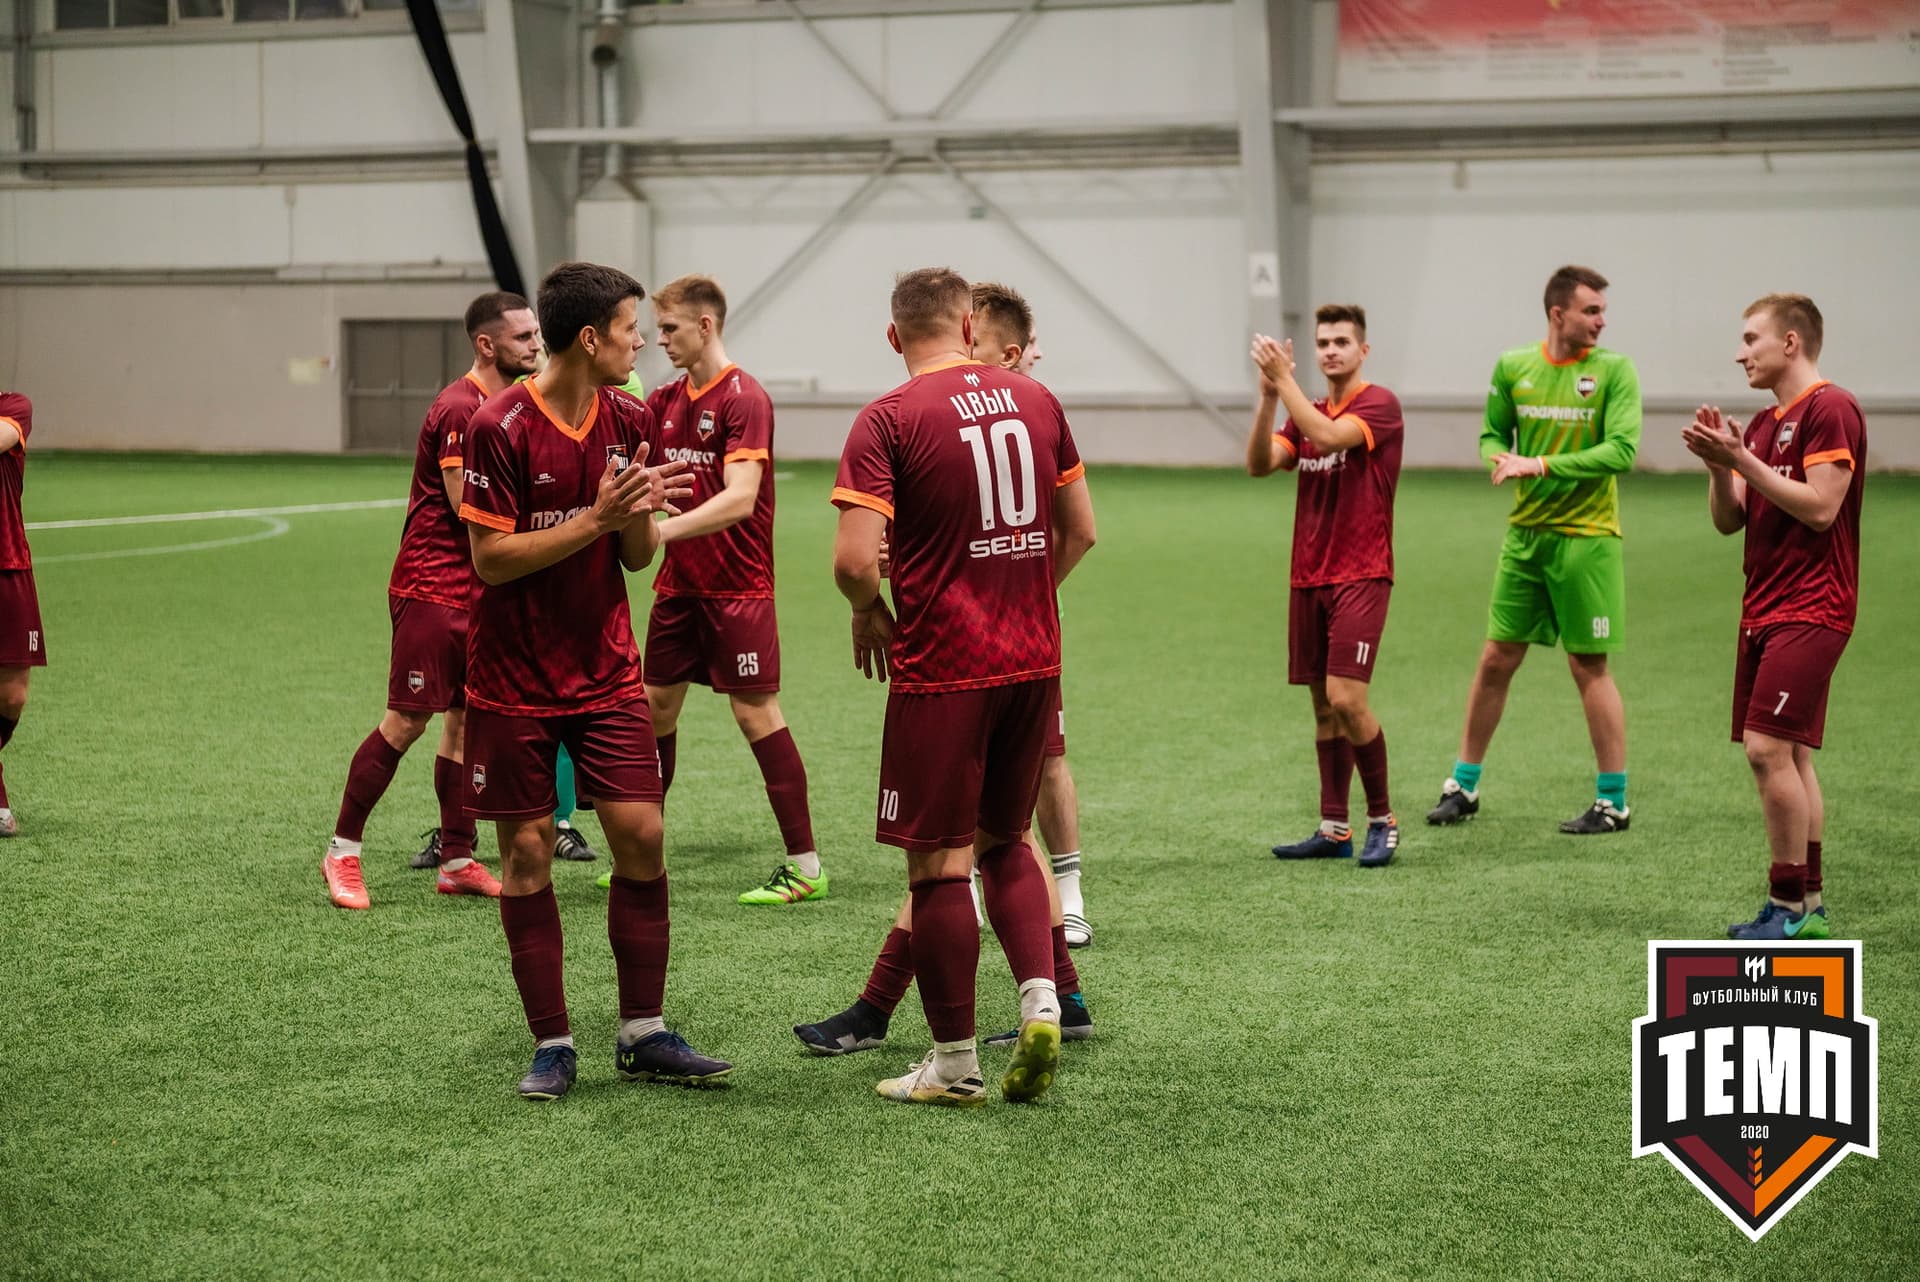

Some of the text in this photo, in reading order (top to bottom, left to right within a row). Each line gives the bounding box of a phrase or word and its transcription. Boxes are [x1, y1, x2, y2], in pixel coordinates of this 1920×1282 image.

[950, 388, 1019, 422] ЦВЫК
[463, 469, 489, 489] ПСБ
[959, 418, 1037, 531] 10
[969, 530, 1046, 558] SEUS
[1593, 616, 1609, 638] 99
[737, 652, 759, 676] 25
[1356, 641, 1370, 665] 11
[1772, 691, 1789, 716] 7
[880, 789, 898, 821] 10
